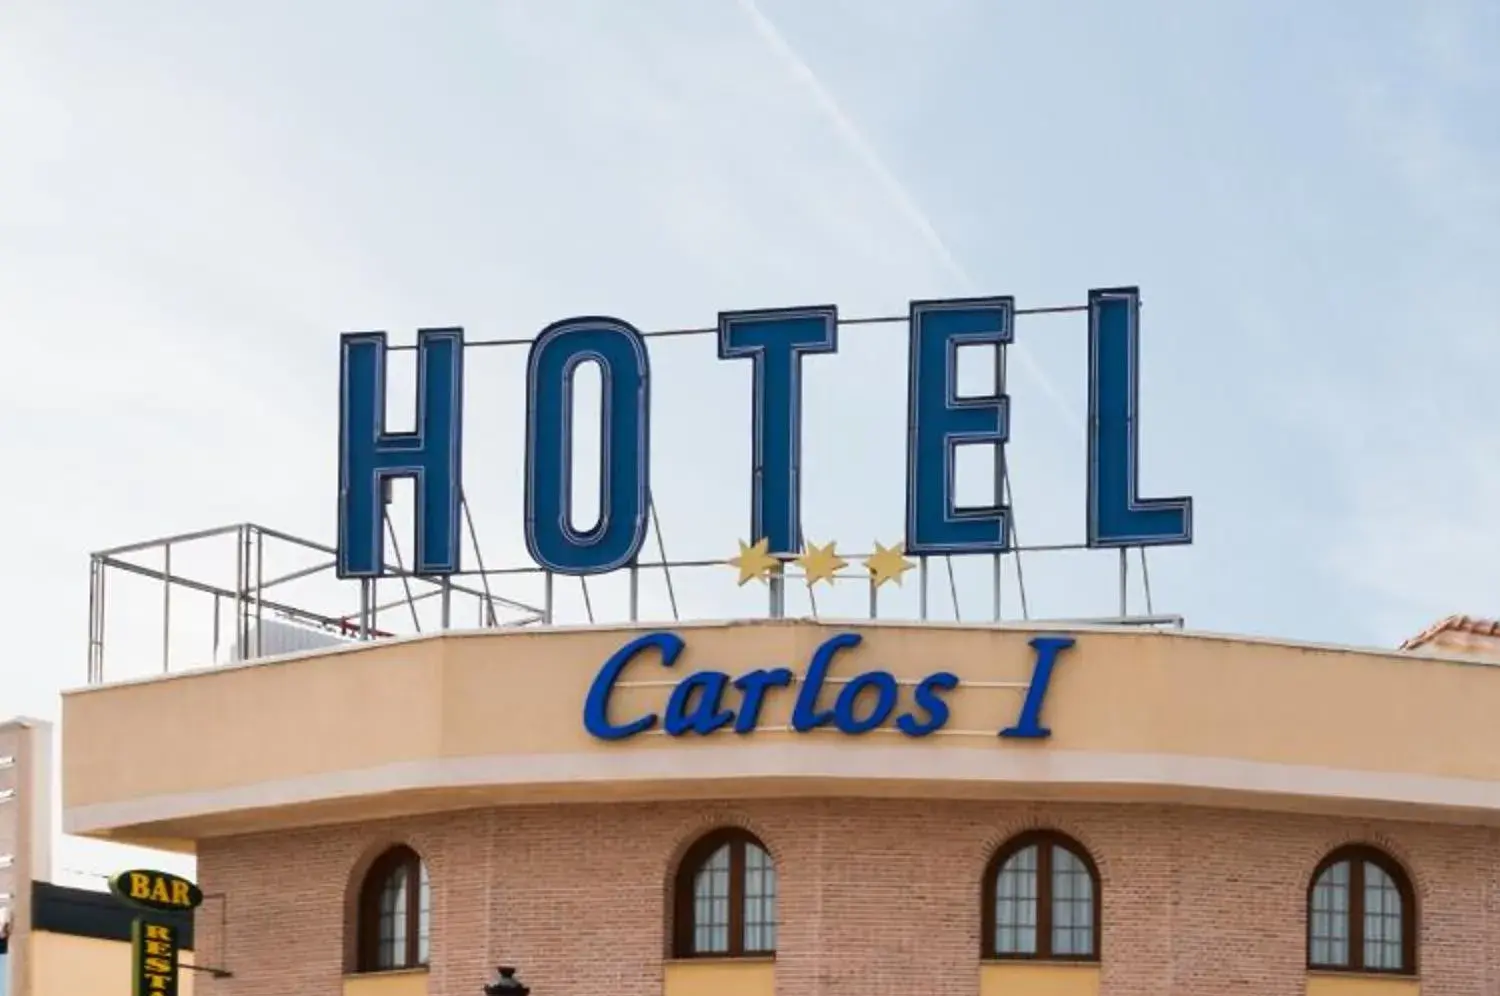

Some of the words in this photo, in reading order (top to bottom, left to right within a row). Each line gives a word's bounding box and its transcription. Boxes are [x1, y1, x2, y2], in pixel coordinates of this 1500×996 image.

[335, 286, 1193, 579] HOTEL
[583, 631, 960, 741] Carlos
[997, 636, 1077, 739] I
[129, 872, 192, 907] BAR
